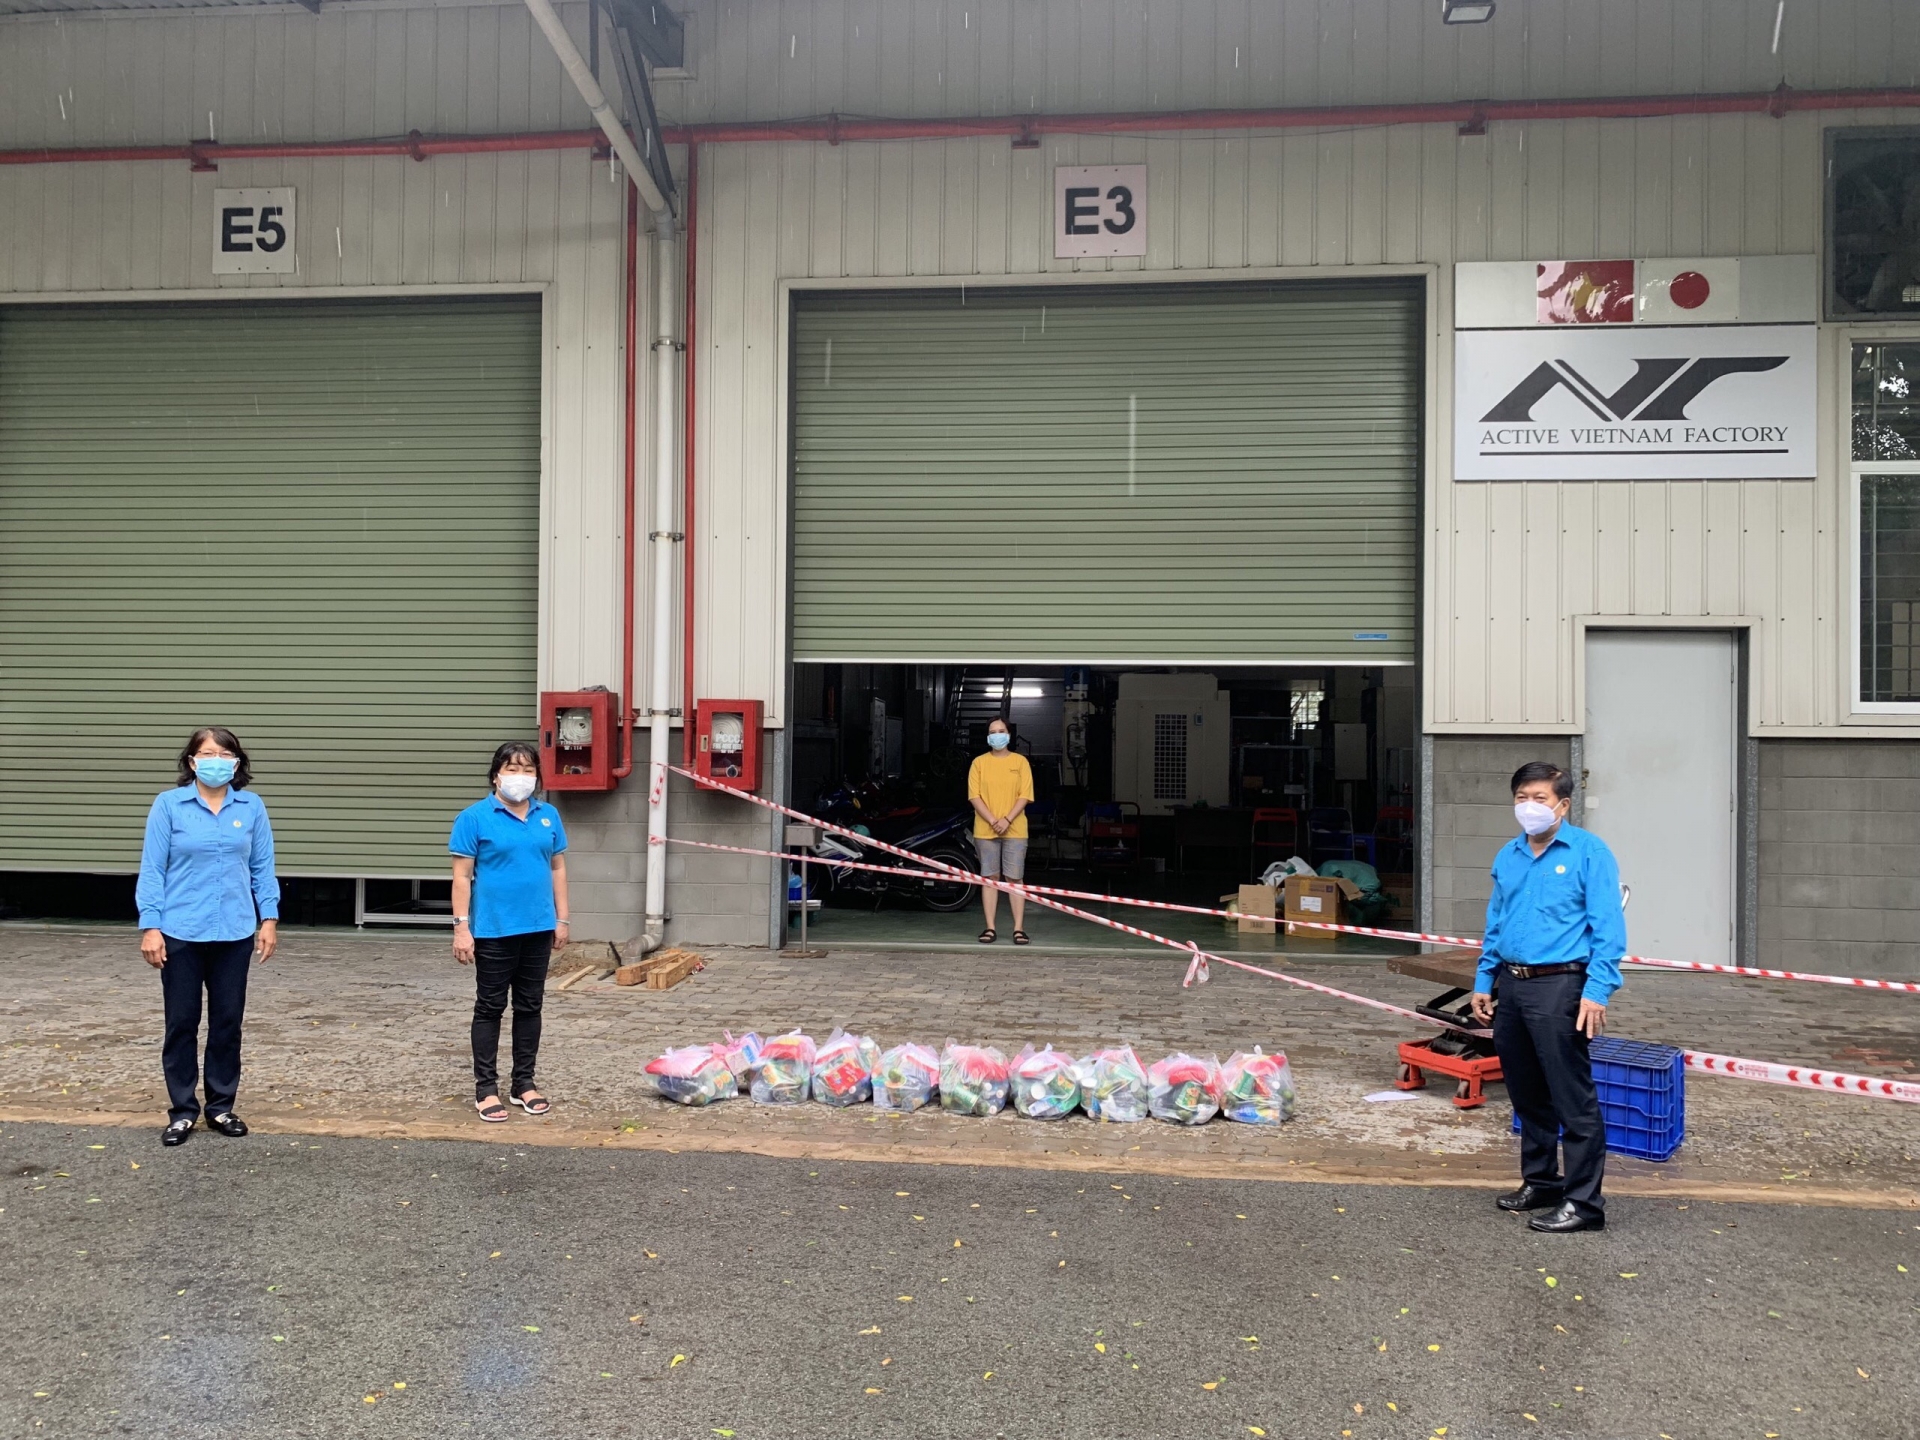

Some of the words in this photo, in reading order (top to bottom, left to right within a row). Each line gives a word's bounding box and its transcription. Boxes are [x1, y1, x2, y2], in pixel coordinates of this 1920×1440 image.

[221, 206, 286, 253] E5
[1064, 185, 1136, 236] E3
[1479, 428, 1560, 445] ACTIVE
[1569, 427, 1673, 444] VIETNAM
[1683, 426, 1789, 443] FACTORY
